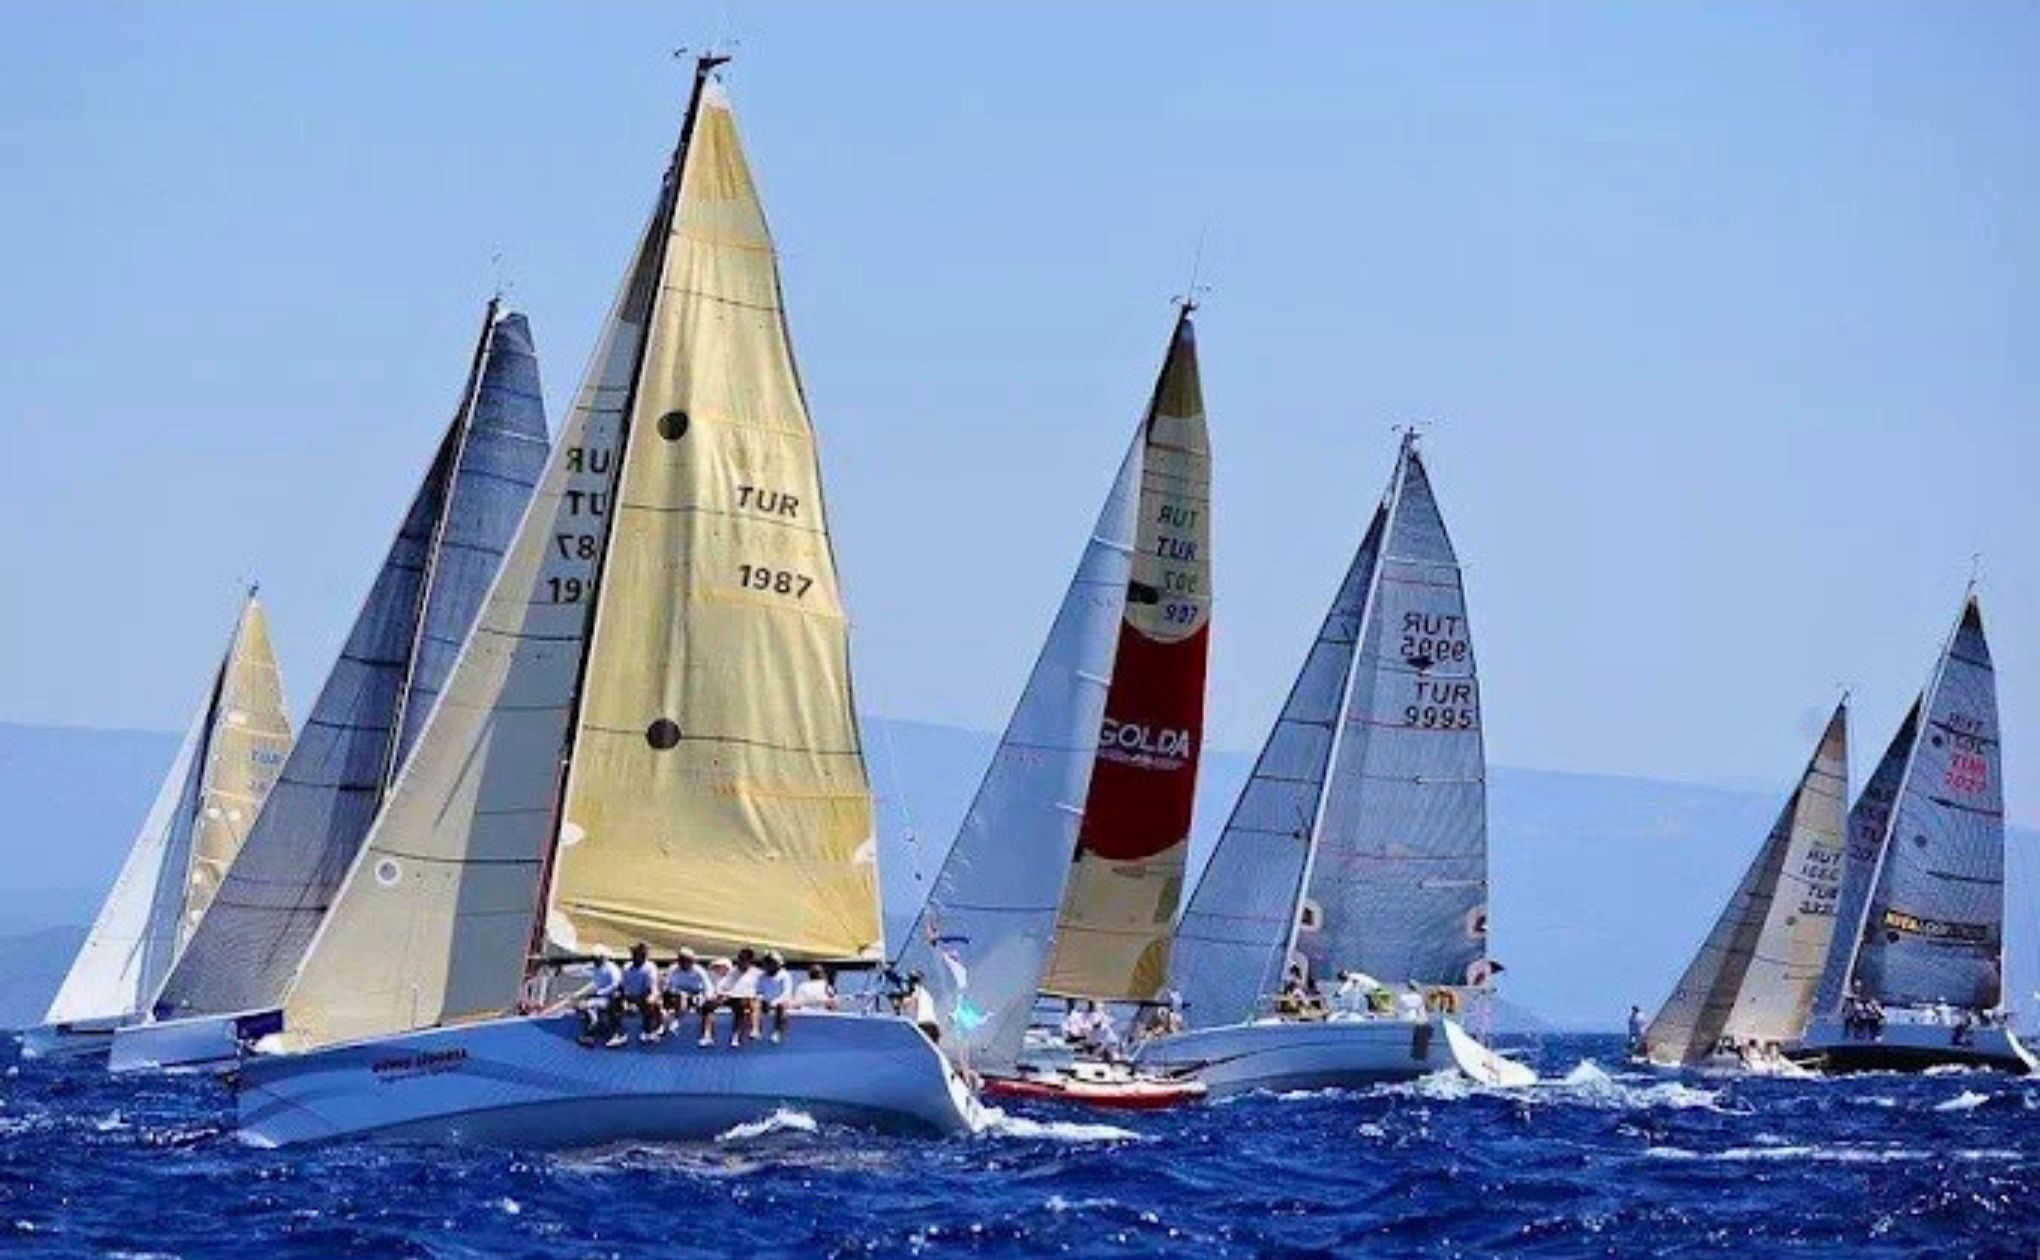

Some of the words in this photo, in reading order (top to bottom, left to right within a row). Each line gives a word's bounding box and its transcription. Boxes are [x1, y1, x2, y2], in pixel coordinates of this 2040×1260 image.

[737, 485, 800, 518] TUR
[737, 565, 814, 600] 1987
[1414, 681, 1472, 704] TUR
[1405, 705, 1474, 729] 9995
[1101, 719, 1189, 757] GOLDA
